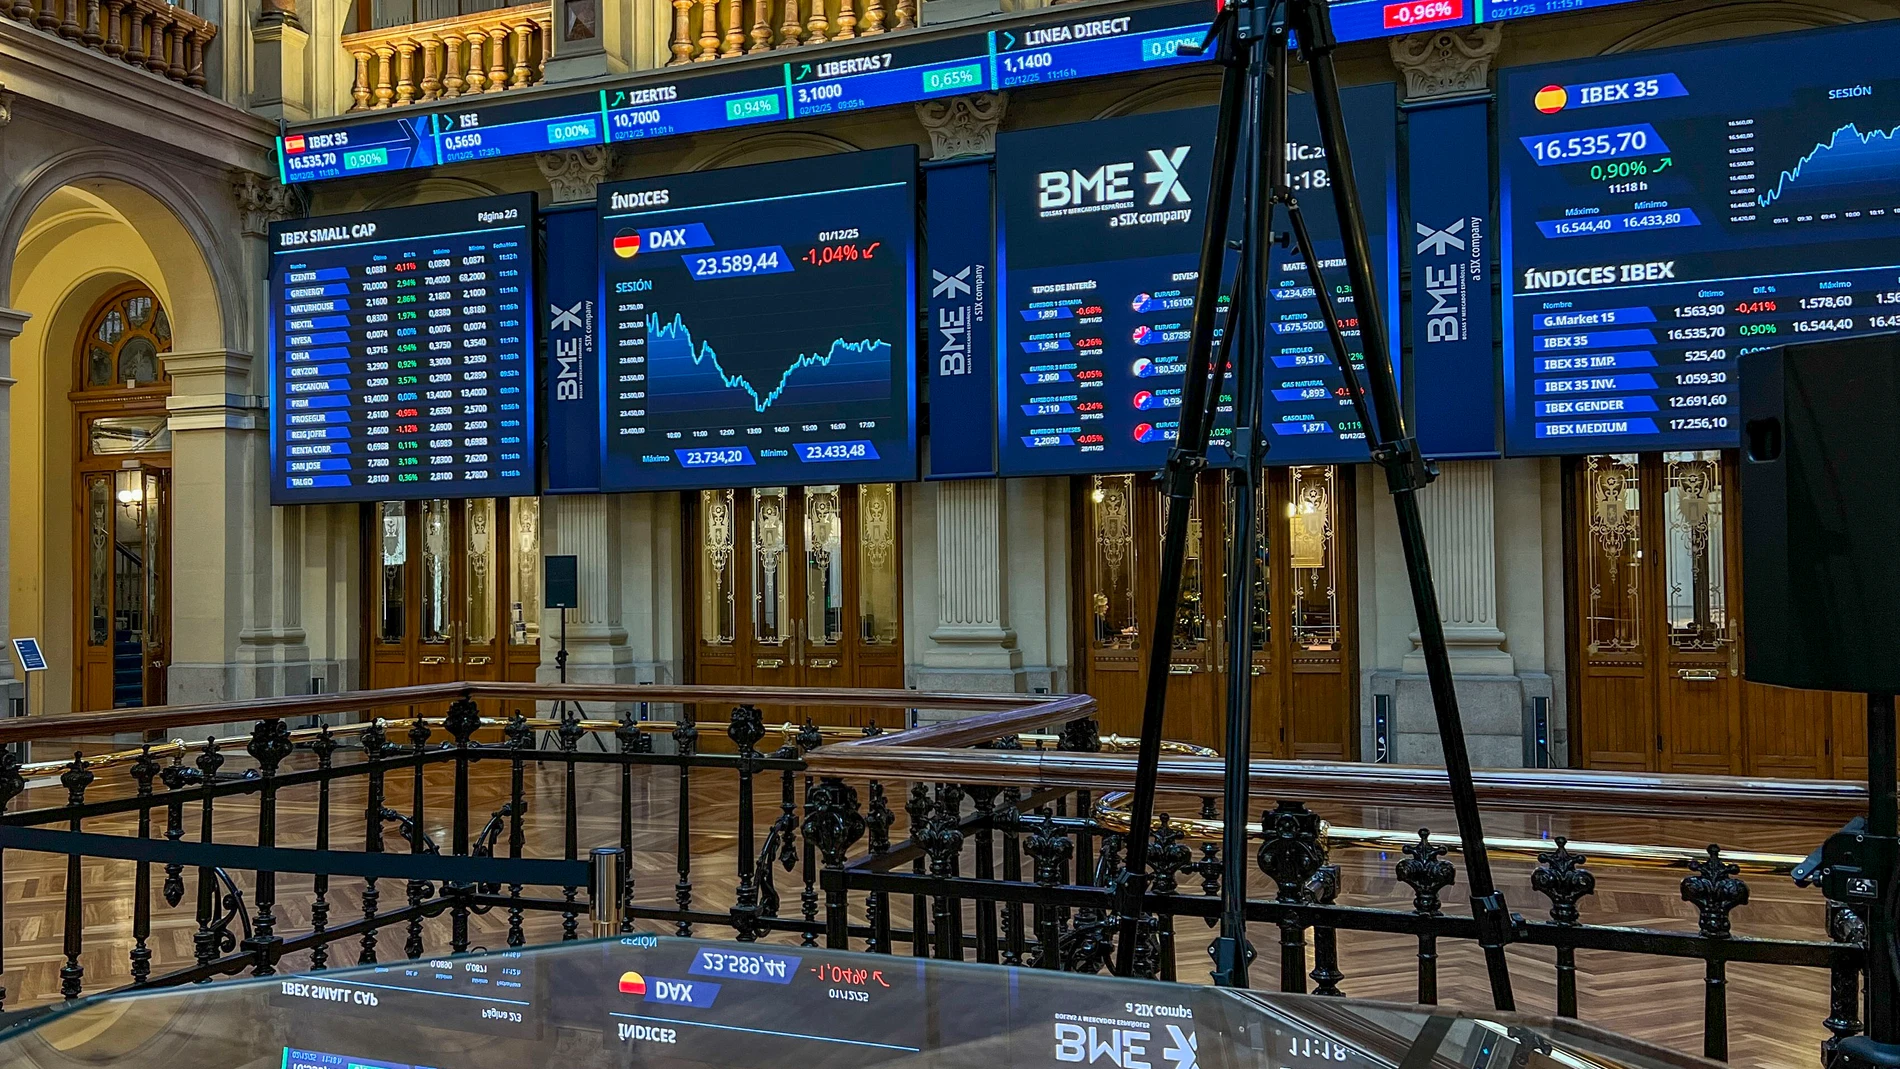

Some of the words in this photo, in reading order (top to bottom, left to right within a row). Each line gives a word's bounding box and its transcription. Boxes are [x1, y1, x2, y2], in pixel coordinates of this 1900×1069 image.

[1392, 2, 1451, 22] -0,96%
[1492, 4, 1536, 18] 02/12/25
[1025, 25, 1072, 46] LINEA
[1075, 17, 1130, 37] DIRECT
[817, 55, 880, 78] LIBERTAS
[883, 53, 892, 66] 7
[1004, 53, 1051, 72] 1,1400
[932, 70, 972, 88] 0,65%
[1005, 73, 1039, 85] 02/12/25
[1048, 70, 1068, 79] 11:16
[630, 86, 677, 104] IZERTIS
[798, 84, 842, 102] 3,1000
[1581, 83, 1629, 104] IBEX
[1634, 80, 1658, 98] 35
[1828, 85, 1872, 100] SESIÓN
[734, 102, 771, 115] 0,94%
[460, 114, 478, 127] ISE
[614, 110, 660, 127] 10,7000
[555, 126, 589, 139] 0,00%
[615, 129, 644, 139] 02/12/25
[309, 133, 333, 149] IBEX
[334, 132, 348, 146] 35
[446, 134, 481, 149] 0,5650
[1534, 131, 1647, 160] 16.535,70
[289, 153, 336, 170] 16.535,70
[351, 155, 381, 167] 0,90%
[1590, 161, 1647, 181] 0,90%
[1039, 162, 1134, 209] BME
[1608, 182, 1638, 194] 11:18
[1640, 181, 1648, 190] h
[612, 190, 669, 209] ÍNDICES
[1566, 206, 1599, 216] Máximo
[1634, 200, 1667, 209] Mínimo
[478, 211, 503, 223] Página
[505, 209, 518, 219] 2/3
[1110, 217, 1118, 227] a
[1120, 213, 1138, 226] SIX
[1140, 209, 1192, 226] company
[1555, 219, 1611, 233] 16.544,40
[1623, 213, 1681, 228] 16.433,80
[281, 230, 308, 246] IBEX
[310, 226, 349, 243] SMALL
[352, 223, 376, 238] CAP
[650, 229, 686, 249] DAX
[819, 229, 858, 242] 01/12/25
[1470, 217, 1482, 258] company
[802, 245, 858, 266] -1,04%
[697, 252, 778, 275] 23.589,44
[1470, 259, 1480, 274] SIX
[291, 272, 316, 282] EZENTIS
[976, 264, 984, 301] company
[1525, 266, 1616, 290] ÍNDICES
[1620, 261, 1674, 282] IBEX
[397, 279, 416, 287] 2,94%
[616, 280, 652, 293] SESIÓN
[1032, 286, 1054, 294] TIPOS
[1066, 280, 1096, 290] INTERÉS
[291, 288, 324, 298] GRENERGY
[1543, 302, 1572, 310] Nombre
[1698, 289, 1724, 298] Último
[1819, 281, 1851, 290] Máximo
[291, 302, 334, 313] NATURHOUSE
[974, 301, 983, 315] SIX
[1162, 299, 1193, 308] 1,16100
[1426, 264, 1459, 342] BME
[1673, 304, 1725, 318] 1.563,90
[1735, 301, 1776, 314] -0,41%
[1799, 296, 1852, 309] 1.578,60
[585, 301, 593, 333] company
[1038, 310, 1057, 319] 1,891
[1076, 307, 1102, 315] -0,68%
[1544, 314, 1598, 327] G.Market
[1600, 312, 1615, 323] 15
[291, 320, 313, 329] NEXTIL
[1278, 321, 1323, 332] 1.675,5000
[1668, 327, 1725, 341] 16.535,70
[1740, 324, 1777, 336] 0,90%
[1793, 318, 1853, 333] 16.544,40
[291, 336, 312, 344] NYESA
[940, 306, 965, 376] BME
[1038, 342, 1059, 351] 1,946
[1076, 339, 1102, 347] -0,26%
[1544, 337, 1572, 348] IBEX
[1573, 336, 1588, 346] 35
[291, 352, 309, 360] OHLA
[1296, 354, 1324, 365] 59,510
[1544, 358, 1571, 370] IBEX
[1574, 357, 1588, 368] 35
[1590, 356, 1616, 367] IMP.
[1685, 350, 1725, 362] 525,40
[292, 367, 318, 376] ORYZON
[557, 338, 577, 400] BME
[398, 376, 417, 384] 3,57%
[1545, 381, 1572, 392] IBEX
[1574, 380, 1588, 390] 35
[1591, 379, 1616, 389] INV.
[1676, 372, 1726, 385] 1.059,30
[292, 382, 329, 391] PESCANOVA
[1301, 389, 1324, 398] 4,893
[1038, 405, 1059, 414] 2,110
[1077, 402, 1103, 411] -0,24%
[1545, 403, 1572, 413] IBEX
[1575, 400, 1624, 412] GENDER
[1669, 395, 1727, 407] 12.691,60
[292, 414, 325, 423] PROSEGUR
[1669, 418, 1727, 430] 17.256,10
[396, 425, 418, 433] -1,12%
[1302, 423, 1324, 432] 1,871
[1546, 425, 1573, 435] IBEX
[1576, 422, 1627, 434] MEDIUM
[292, 446, 312, 454] RENTA
[687, 450, 742, 464] 23.734,20
[761, 448, 788, 457] Mínimo
[807, 444, 865, 459] 23.433,48
[642, 454, 670, 463] Máximo
[305, 462, 320, 471] JOSE
[292, 478, 313, 486] TALGO
